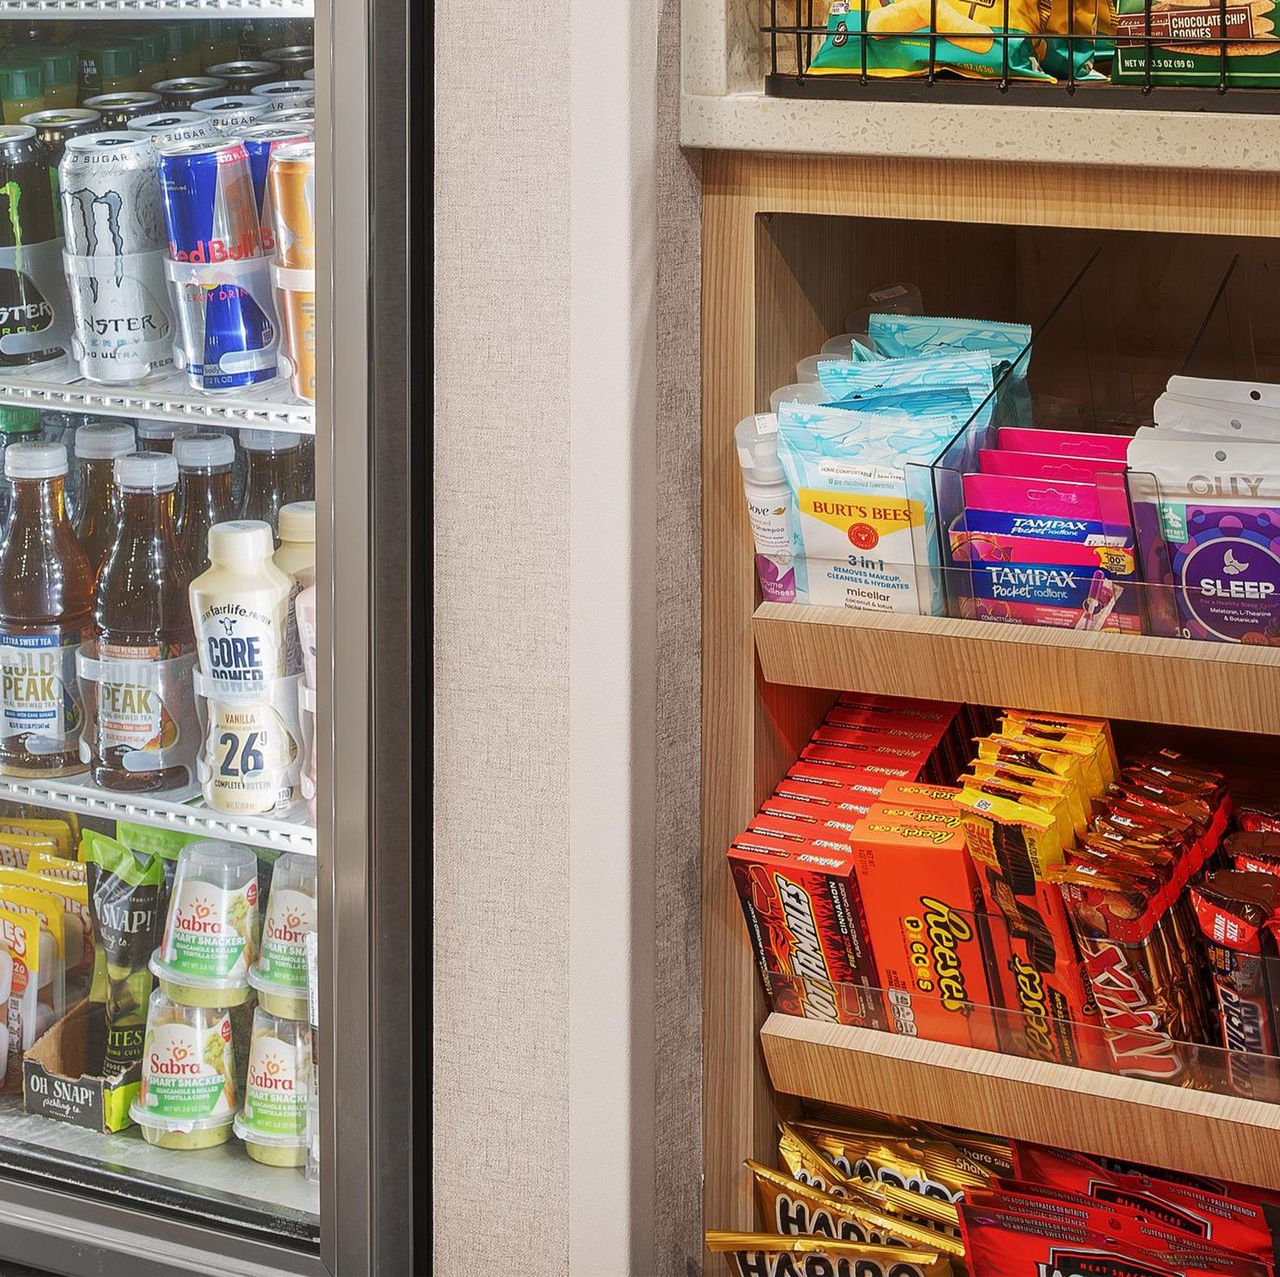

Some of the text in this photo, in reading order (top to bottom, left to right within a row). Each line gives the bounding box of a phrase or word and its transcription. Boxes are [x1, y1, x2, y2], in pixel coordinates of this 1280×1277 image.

[1172, 13, 1246, 29] CHOCOLATE CHIP
[1173, 25, 1212, 38] COOKIES
[213, 117, 254, 127] SUGAR
[165, 129, 206, 141] SUGAR
[84, 155, 128, 163] SUGAR
[812, 501, 911, 521] BURT'S BEES
[1012, 519, 1087, 531] TAMPAX
[833, 567, 901, 583] REMOVES MAKEUP,
[985, 566, 1076, 589] TAMPAX
[847, 588, 890, 601] micellar
[993, 585, 1067, 599] Pocket radiant
[1200, 578, 1274, 598] SLEEP
[20, 636, 38, 646] SWEET
[40, 636, 51, 645] TEA
[208, 637, 261, 667] CORE
[212, 669, 262, 691] POWER
[3, 678, 56, 701] PEAK
[102, 689, 151, 713] PEAK
[224, 714, 255, 724] VANILLA
[102, 911, 152, 933] SNAP!
[177, 910, 220, 935] Sabra
[152, 1054, 200, 1074] Sabra
[149, 1075, 225, 1086] SMART SNACKERS
[249, 1071, 293, 1090] Sabra
[31, 1075, 94, 1106] OH SNAP!
